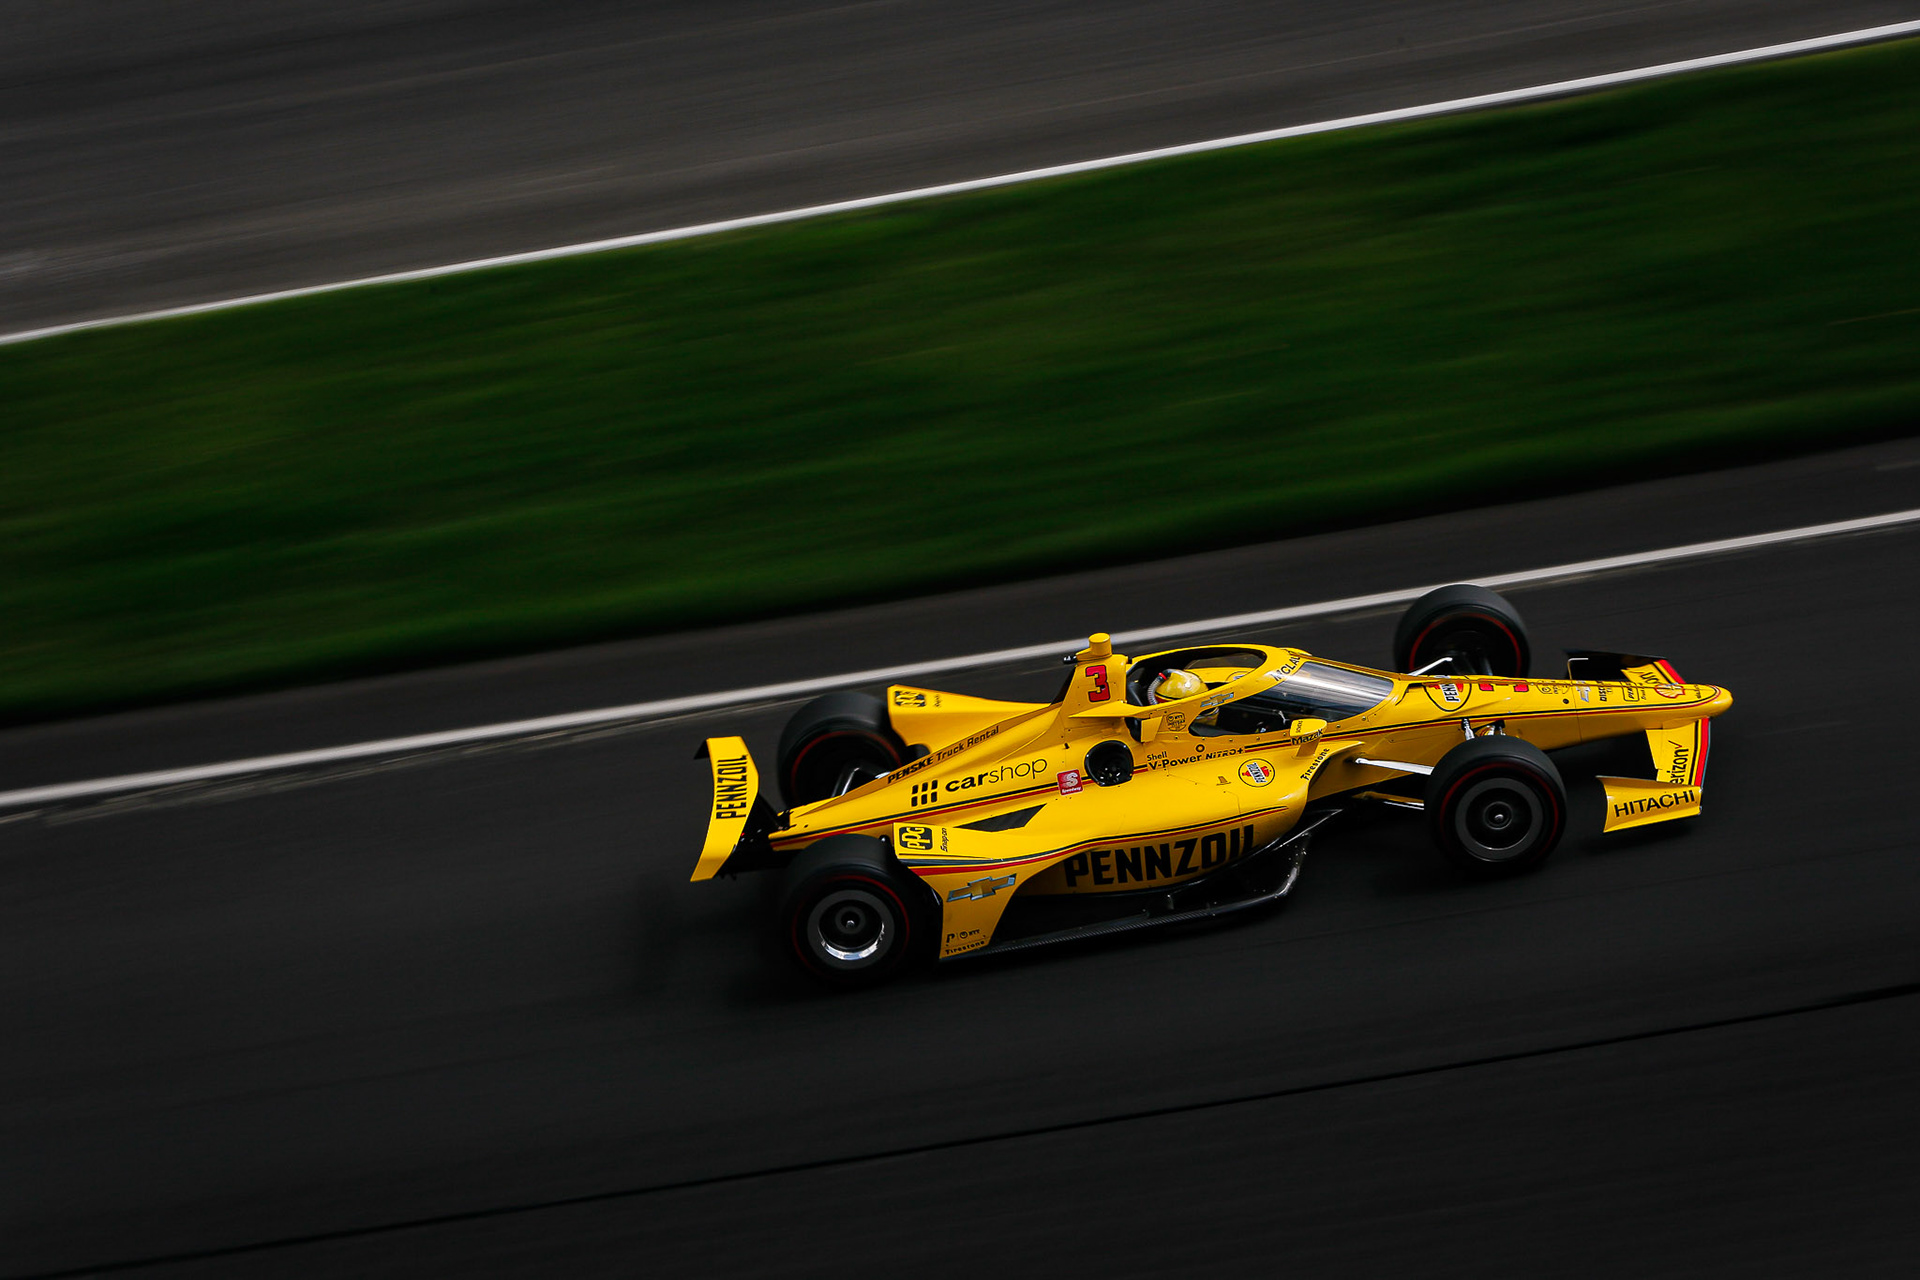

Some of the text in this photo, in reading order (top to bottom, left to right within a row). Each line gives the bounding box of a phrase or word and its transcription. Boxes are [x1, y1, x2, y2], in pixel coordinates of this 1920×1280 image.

[1085, 664, 1111, 703] 3
[1291, 728, 1324, 746] Mazak
[887, 725, 999, 785] PENSKE Truck Rental
[1147, 751, 1168, 762] Shell
[1148, 755, 1202, 771] V-Power
[1300, 748, 1331, 781] Firestone
[1667, 748, 1690, 786] erizon
[716, 754, 748, 820] PENNZOIL
[945, 758, 1048, 792] carshop
[1613, 790, 1696, 818] HITACHI
[1063, 824, 1255, 888] PENNZOIL
